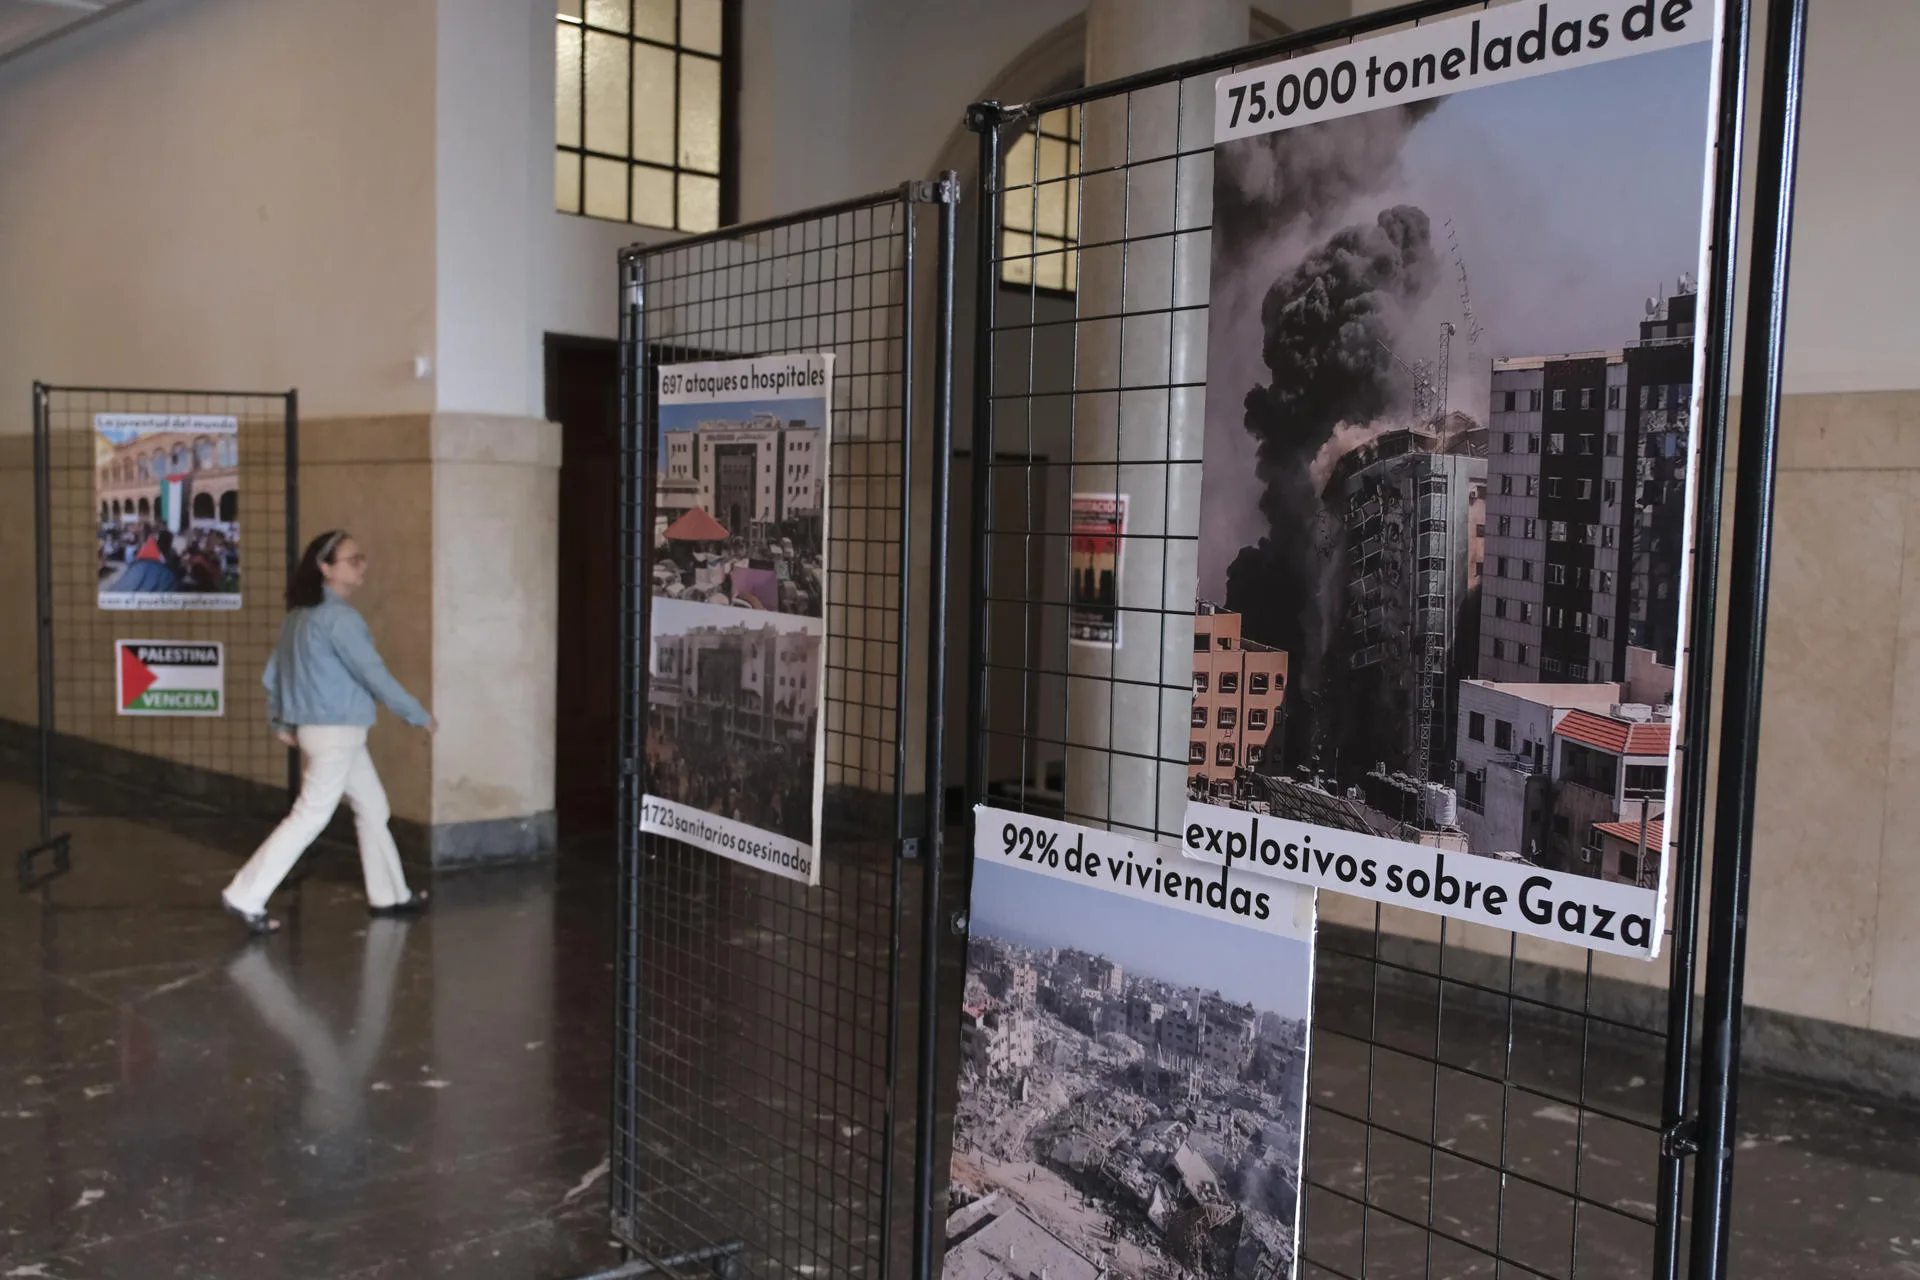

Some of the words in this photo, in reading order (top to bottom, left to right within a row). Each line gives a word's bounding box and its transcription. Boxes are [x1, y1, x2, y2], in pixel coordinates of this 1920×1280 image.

[1228, 60, 1357, 129] 75.000
[1366, 2, 1610, 98] toneladas
[1621, 0, 1694, 42] de
[662, 373, 683, 395] 697
[685, 372, 738, 398] ataques
[740, 374, 749, 390] a
[751, 359, 825, 395] hospitales
[138, 646, 217, 663] PALESTINA
[641, 803, 674, 829] 1723
[675, 815, 736, 849] sanitarios
[738, 836, 812, 876] asesinados
[1002, 823, 1059, 869] 92%
[1064, 832, 1101, 878] de
[1107, 851, 1271, 921] viviendas
[1186, 817, 1377, 888] explosivos
[1385, 853, 1508, 916] sobre
[1518, 875, 1652, 949] Gaza
